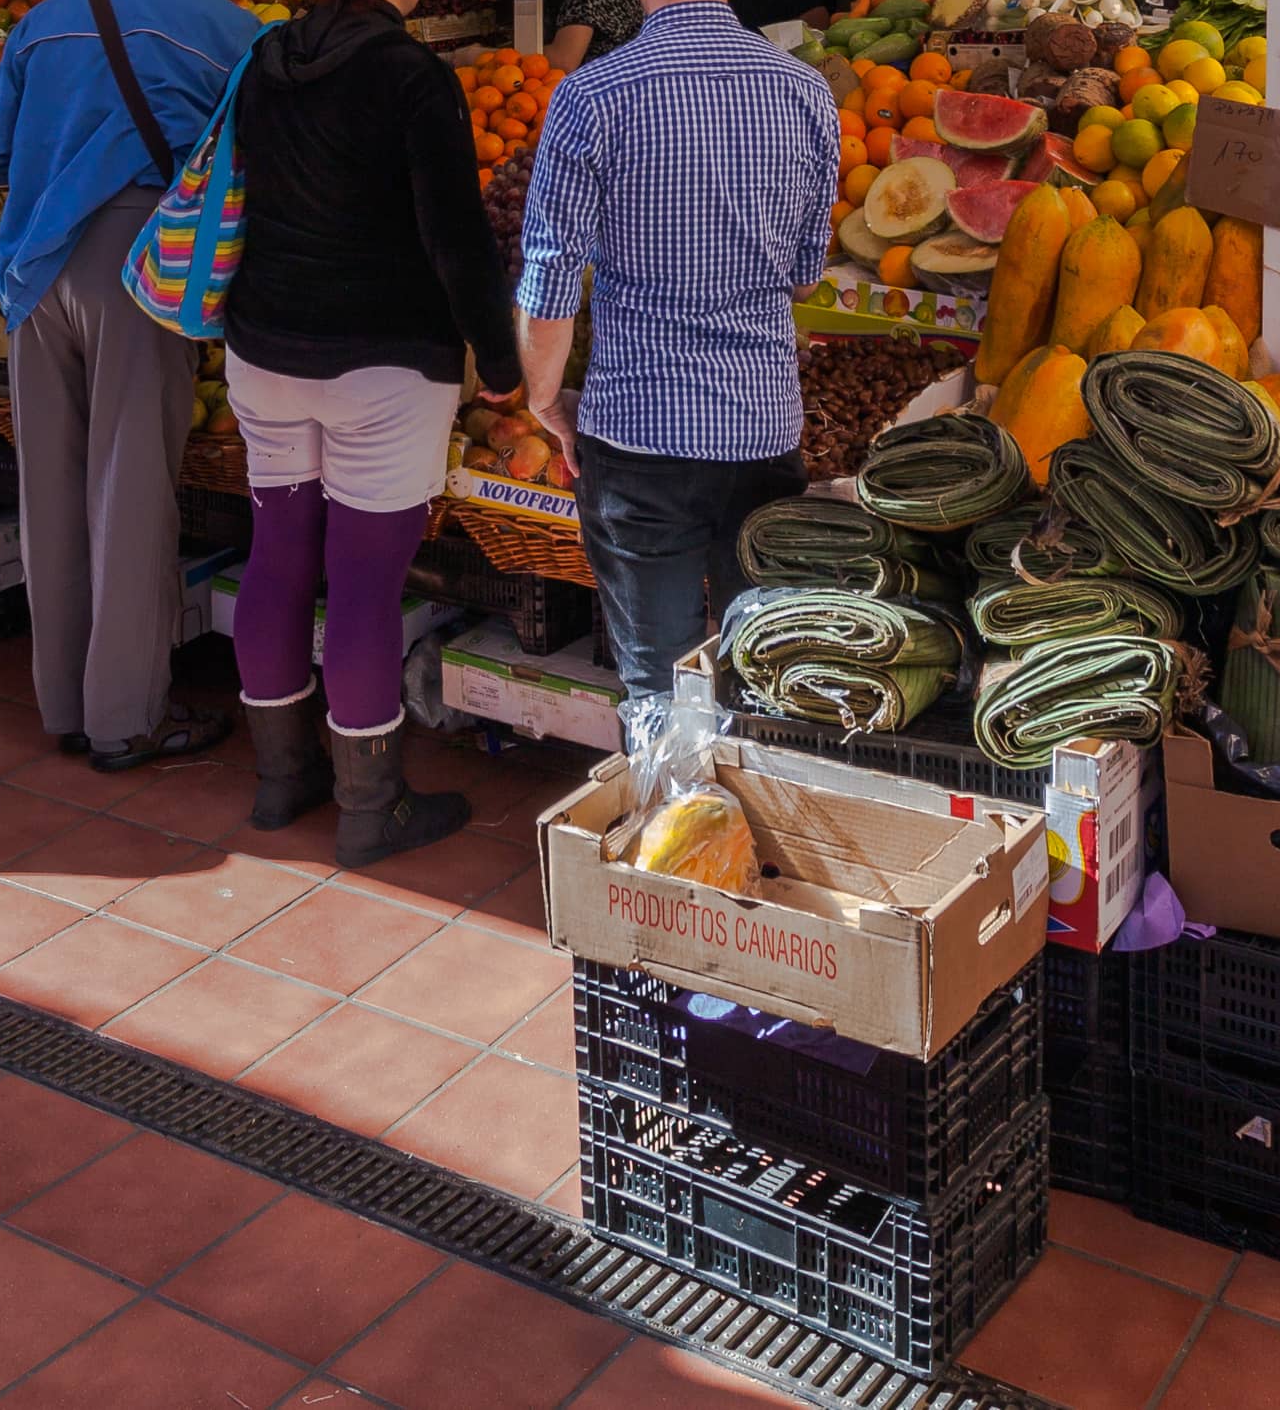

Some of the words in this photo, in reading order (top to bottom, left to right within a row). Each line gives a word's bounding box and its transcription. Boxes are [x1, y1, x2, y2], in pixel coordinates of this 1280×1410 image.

[478, 480, 577, 517] NOVOFRUT
[608, 883, 728, 947] PRODUCTOS
[735, 916, 838, 980] CANARIOS
